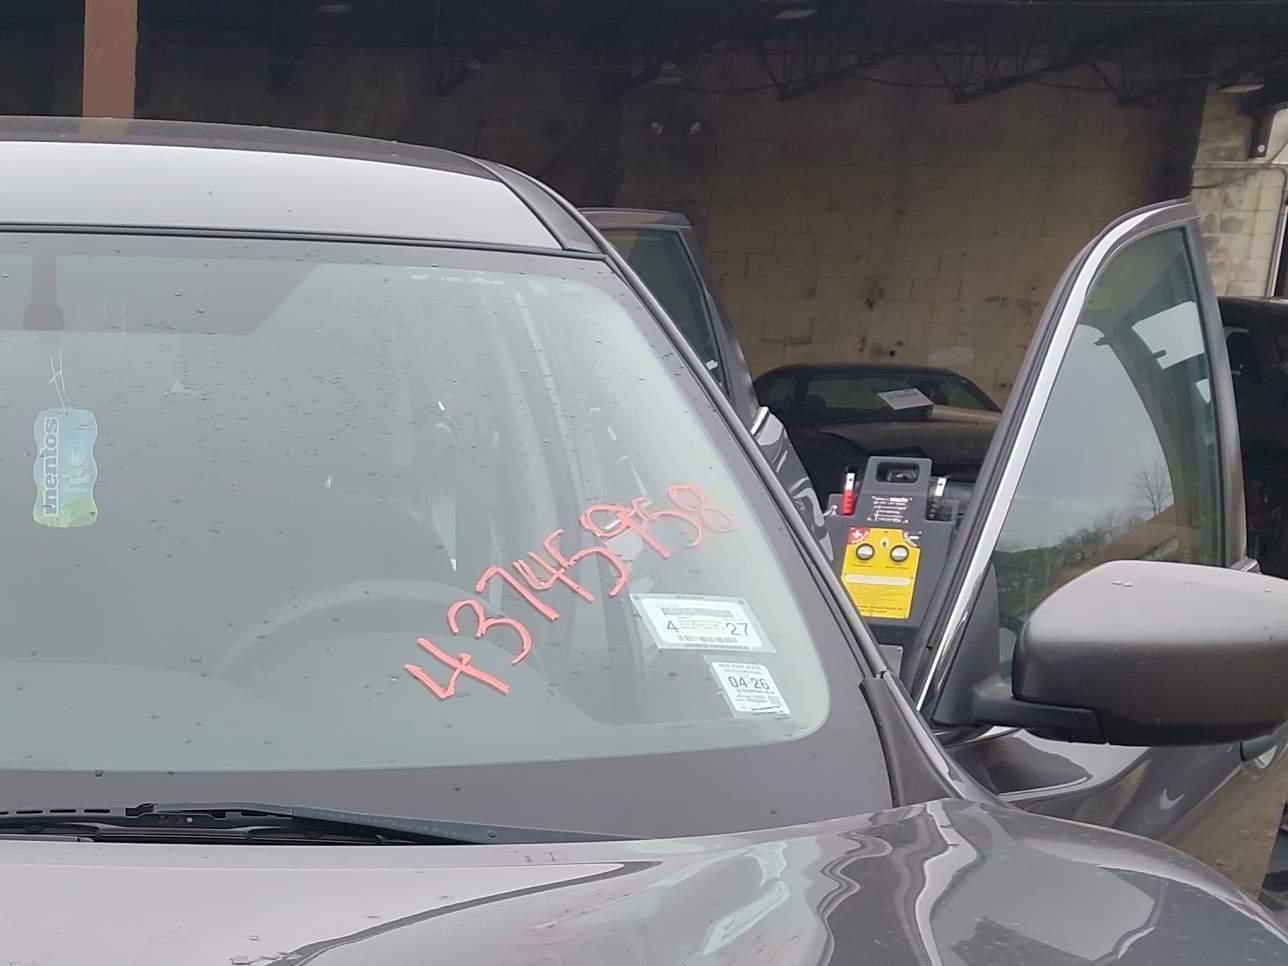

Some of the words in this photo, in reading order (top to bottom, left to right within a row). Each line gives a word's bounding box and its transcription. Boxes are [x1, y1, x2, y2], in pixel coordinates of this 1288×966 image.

[43, 416, 58, 517] mentos
[404, 483, 736, 700] 43745958
[667, 620, 679, 633] 4
[726, 622, 749, 636] 27
